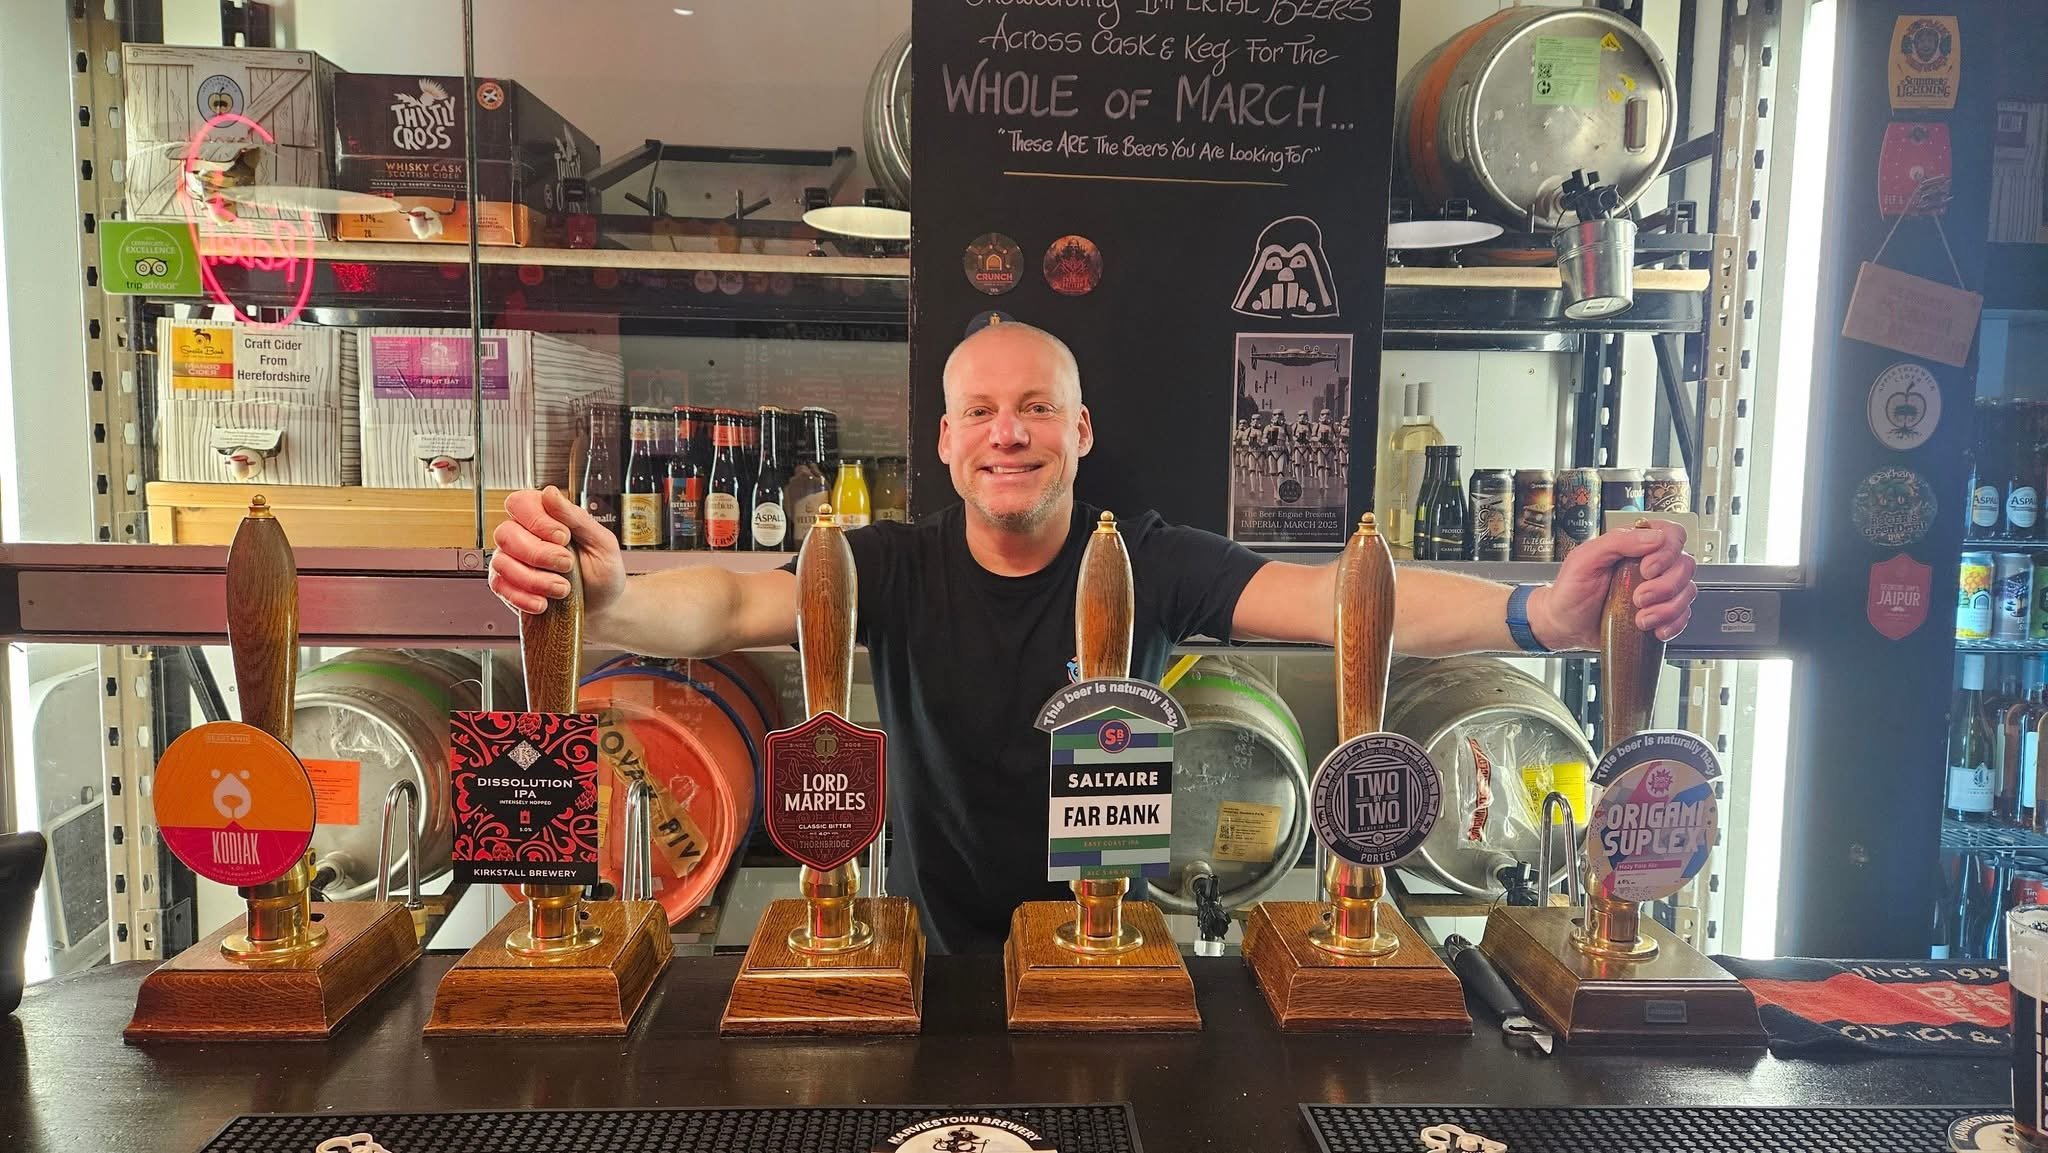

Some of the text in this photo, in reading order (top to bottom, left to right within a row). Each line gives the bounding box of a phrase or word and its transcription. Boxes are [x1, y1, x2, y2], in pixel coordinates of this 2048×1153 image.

[979, 12, 1083, 53] Across
[1092, 30, 1157, 56] Cask
[1159, 37, 1176, 61] &
[1185, 33, 1241, 77] Keg
[1245, 38, 1284, 63] For
[1284, 35, 1340, 65] The
[942, 58, 1079, 118] WHOLE
[1104, 88, 1153, 120] OF
[391, 97, 456, 129] THISTLY
[393, 125, 452, 150] CROSS
[1056, 131, 1089, 158] ARE
[1092, 135, 1119, 157] The
[1121, 135, 1169, 158] Beers
[1198, 142, 1225, 163] Are
[1229, 142, 1285, 172] Looking
[385, 162, 463, 174] WHISKY CASK
[388, 171, 430, 179] SCOTTISH
[126, 246, 177, 255] EXCELLENCE
[976, 273, 1013, 281] CRUNCH
[126, 281, 178, 292] tripadvisor
[244, 338, 302, 351] Craft Cider
[260, 355, 288, 366] From
[237, 370, 311, 383] Herefordshire
[1258, 510, 1276, 519] Beer
[1277, 510, 1303, 520] Engine
[1304, 510, 1336, 518] Presents
[1241, 520, 1338, 529] IMPERIAL MARCH 2025
[1876, 590, 1921, 607] JAIPUR
[1043, 683, 1180, 728] This beer is naturally hazy
[1597, 735, 1716, 780] This beer is naturally hazy
[477, 777, 573, 789] DISSOLUTION
[803, 773, 849, 792] LORD
[1068, 771, 1159, 788] SALTAIRE
[1355, 770, 1400, 798] TWO
[514, 789, 537, 799] IPA
[784, 792, 866, 812] MARPLES
[1064, 804, 1160, 827] FAR BANK
[1355, 800, 1401, 826] TWO
[1607, 800, 1705, 830] ORIGAMI
[212, 831, 260, 866] KODIAK
[799, 839, 851, 849] THORNBRIDGE
[1602, 830, 1701, 857] SUPLEX
[1360, 850, 1398, 863] PORTER
[473, 868, 577, 878] KIRKSTALL BREWERY
[1851, 964, 1931, 978] INCE
[887, 1115, 1043, 1145] HARVIESTOUN BREWERY
